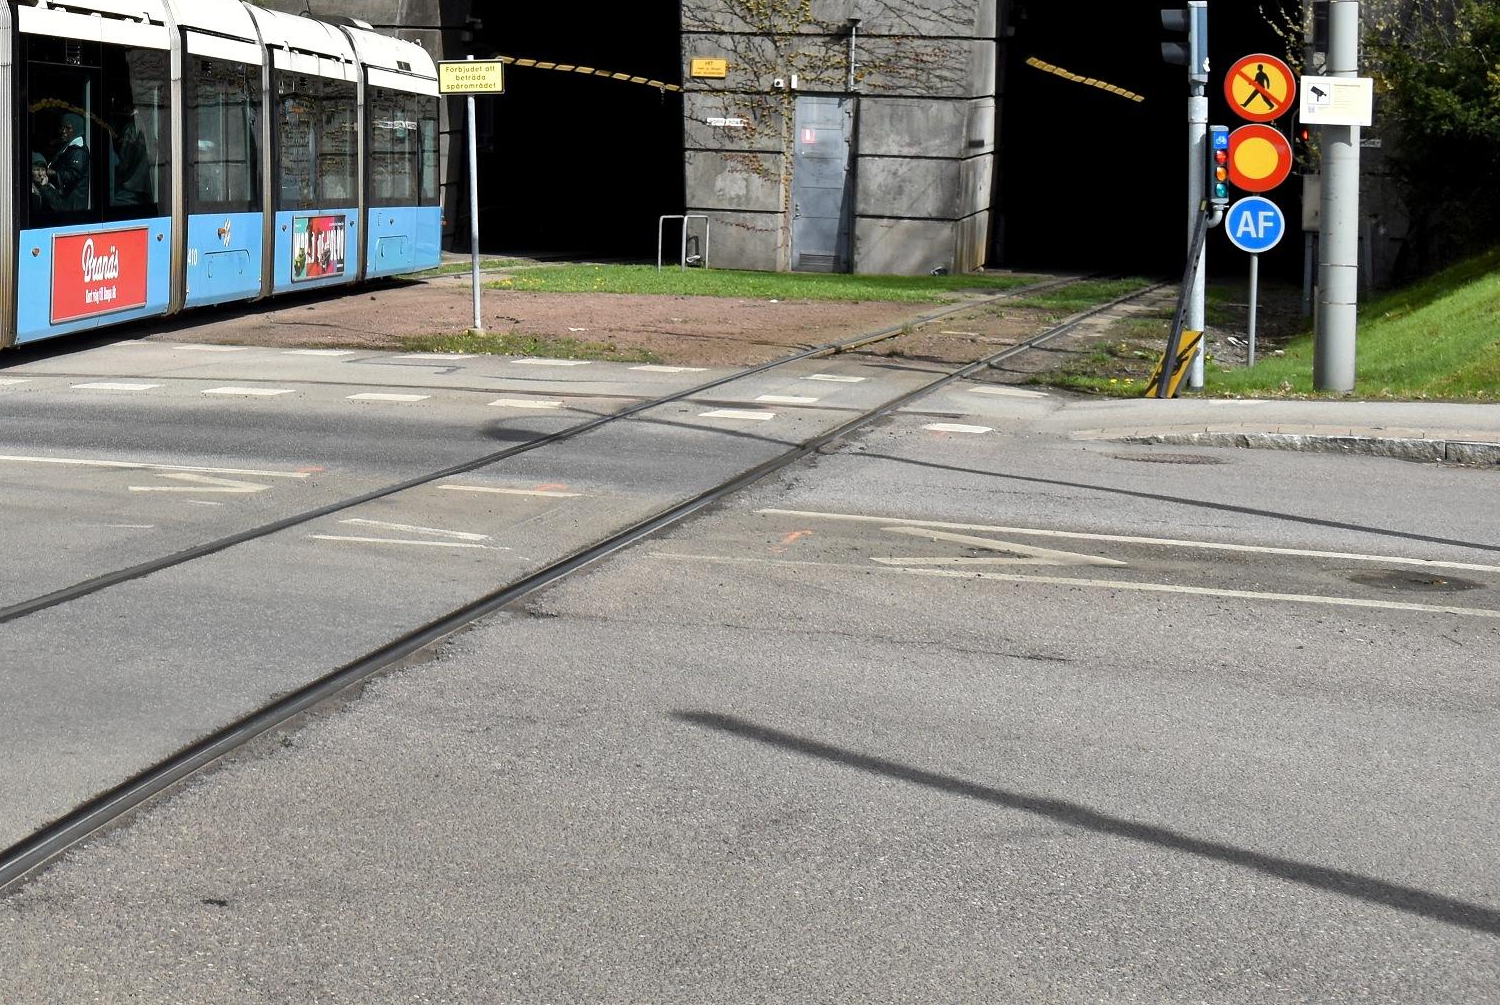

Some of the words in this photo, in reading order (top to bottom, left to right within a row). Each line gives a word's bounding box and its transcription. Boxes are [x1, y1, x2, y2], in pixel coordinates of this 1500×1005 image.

[445, 65, 483, 74] Förbjudet
[455, 73, 486, 81] beträda
[446, 82, 496, 91] spårområdet
[1236, 210, 1275, 238] AF
[81, 238, 119, 283] Branäs
[188, 248, 197, 266] 410
